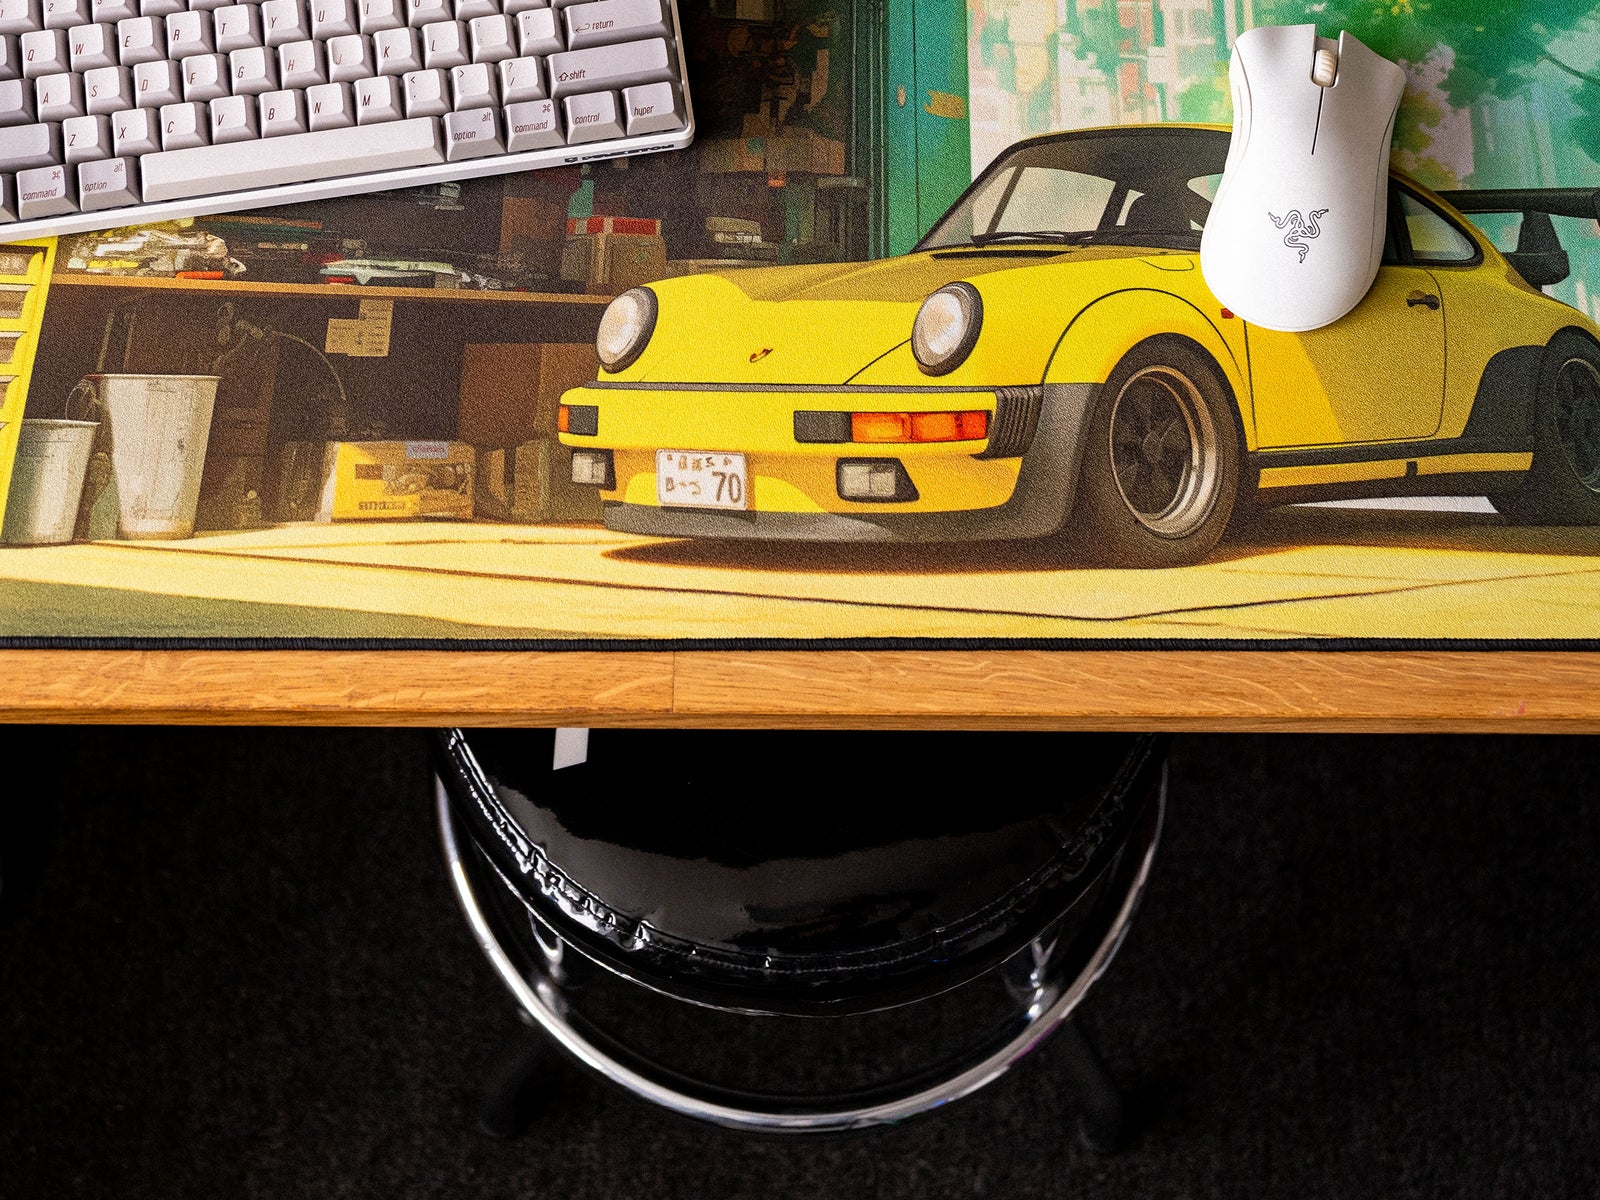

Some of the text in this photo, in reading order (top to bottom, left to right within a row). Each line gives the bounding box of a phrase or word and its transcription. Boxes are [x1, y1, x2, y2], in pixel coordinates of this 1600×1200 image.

[48, 2, 54, 12] 2
[271, 16, 277, 29] Y
[318, 10, 326, 23] U
[221, 23, 227, 35] T
[592, 19, 614, 30] return
[125, 35, 131, 48] E
[173, 29, 180, 41] R
[75, 43, 84, 56] W
[383, 45, 390, 58] K
[431, 39, 436, 52] L
[27, 49, 35, 62] Q
[336, 55, 342, 65] J
[237, 65, 244, 79] G
[287, 59, 295, 72] H
[189, 72, 196, 85] F
[569, 69, 586, 81] shift
[91, 84, 98, 98] S
[141, 79, 149, 92] D
[42, 92, 49, 104] A
[362, 94, 371, 107] M
[268, 107, 275, 121] B
[314, 102, 322, 114] N
[633, 105, 655, 117] hyper
[217, 114, 225, 126] V
[482, 112, 491, 122] alt
[574, 113, 600, 125] control
[118, 126, 127, 139] X
[167, 120, 175, 134] C
[515, 119, 548, 134] command
[69, 134, 76, 147] Z
[453, 130, 477, 142] option
[113, 162, 123, 173] alt
[84, 181, 107, 192] option
[22, 187, 57, 201] command
[712, 471, 742, 503] 70
